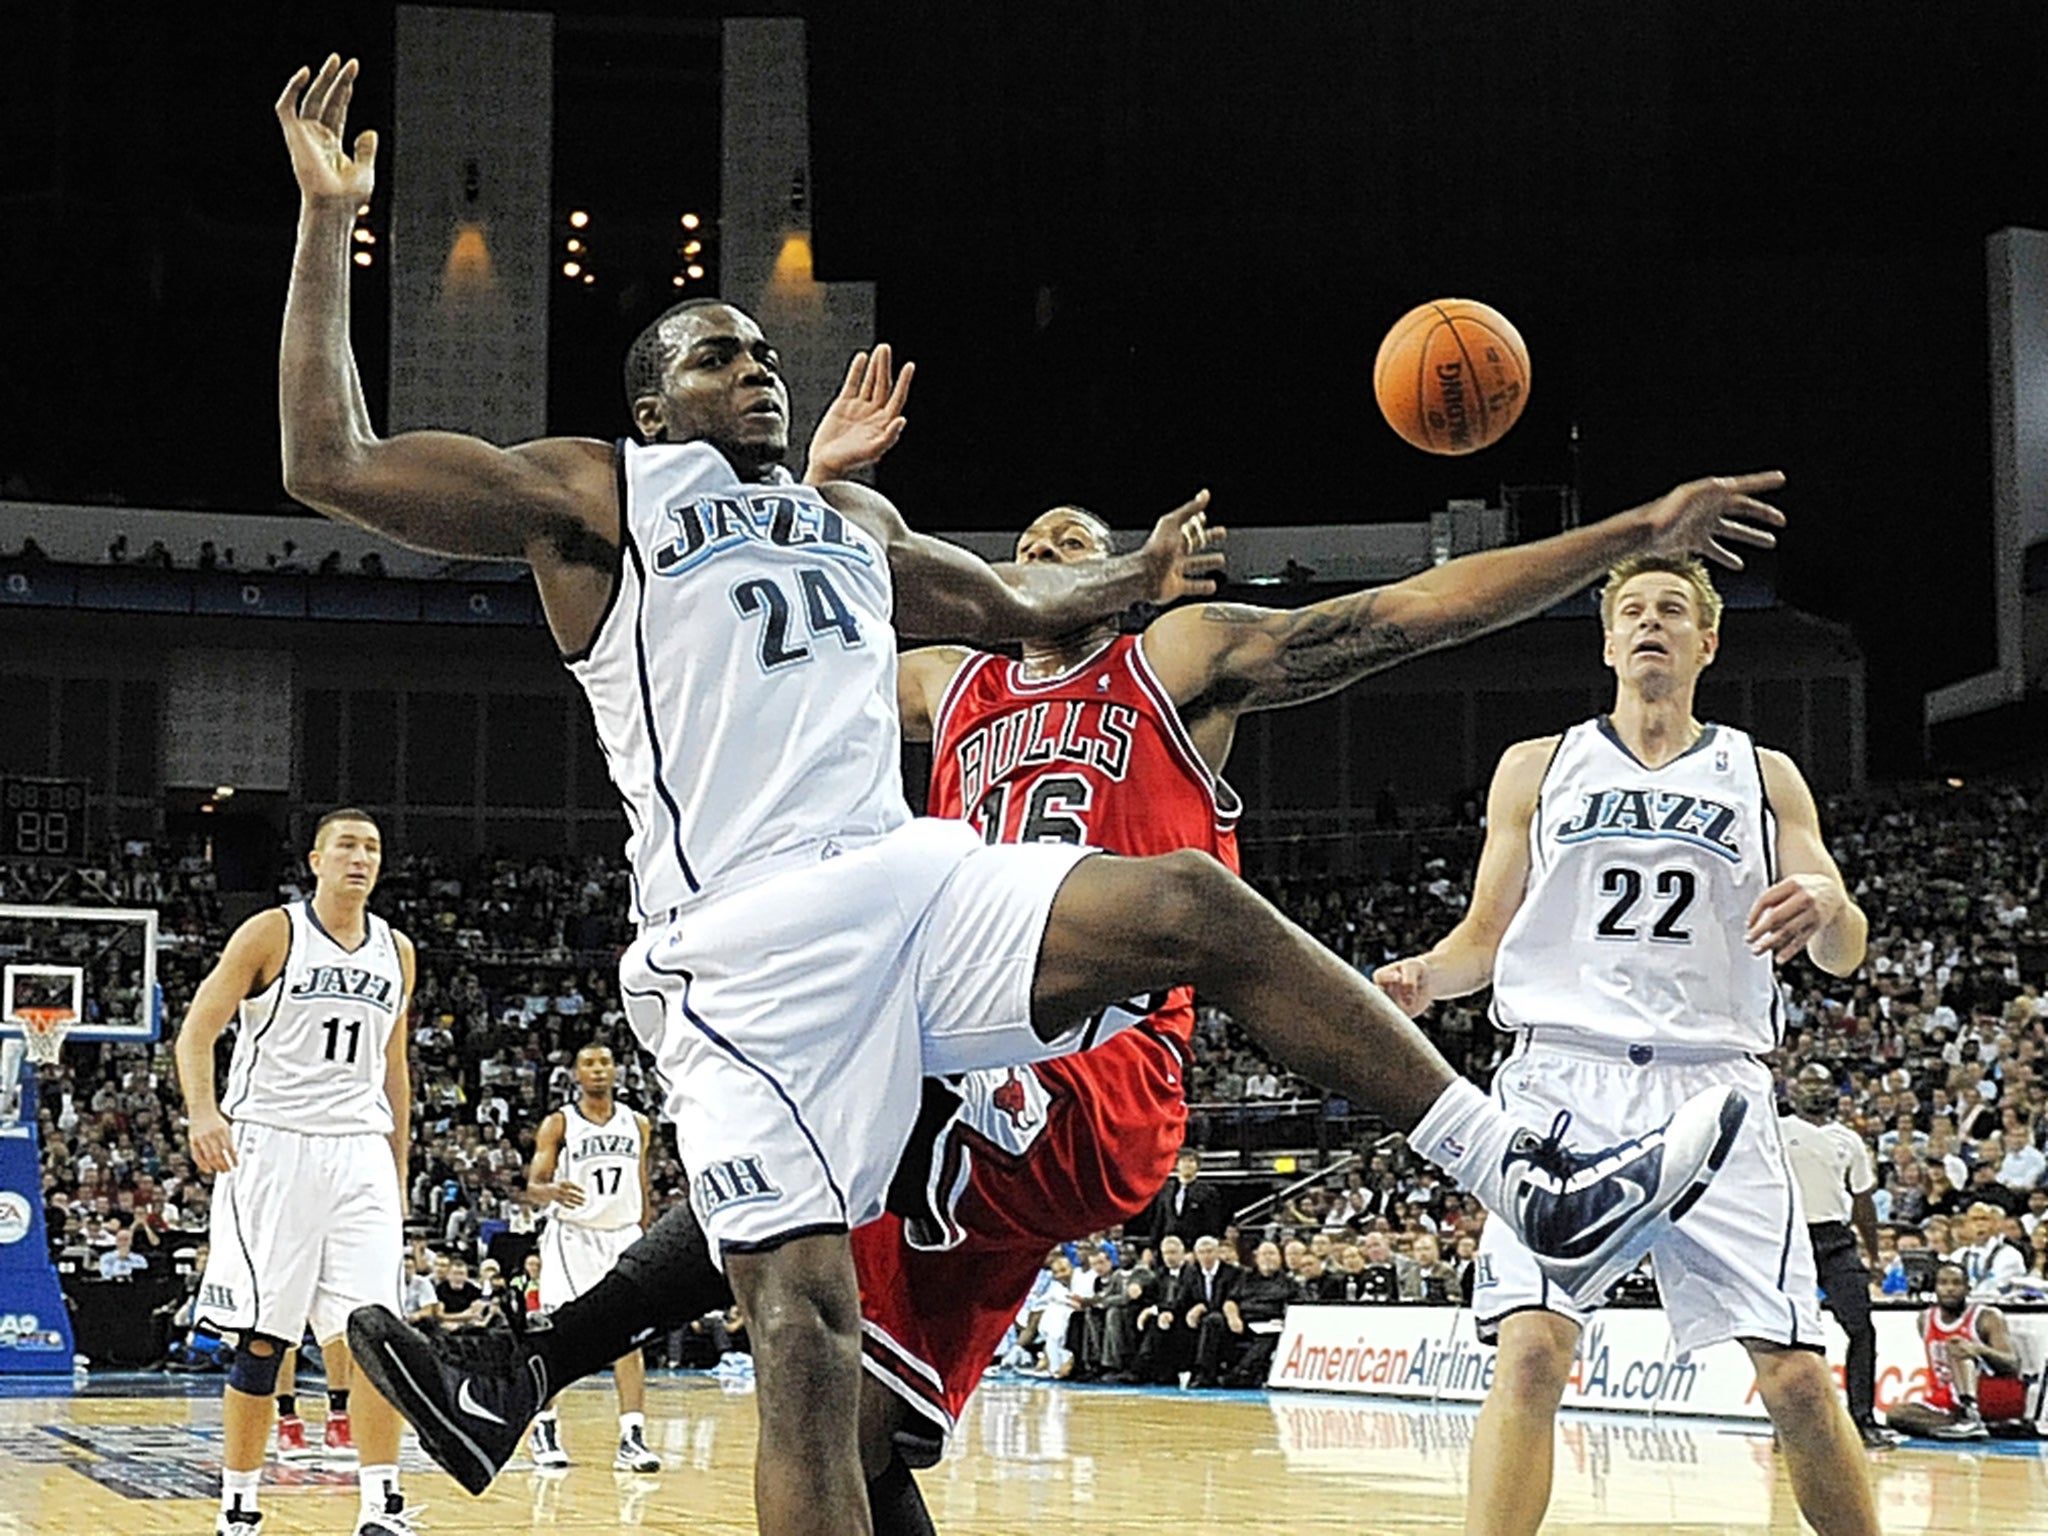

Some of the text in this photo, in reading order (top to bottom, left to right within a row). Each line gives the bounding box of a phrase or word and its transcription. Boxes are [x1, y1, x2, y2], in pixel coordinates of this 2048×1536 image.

[652, 493, 874, 576] JAZZ
[729, 567, 866, 675] 24
[957, 700, 1138, 818] BULLS
[977, 772, 1094, 846] 16
[1554, 787, 1742, 864] JAZZ
[1595, 866, 1696, 944] 22
[290, 965, 394, 1014] JAZZ
[322, 1017, 361, 1064] 11
[572, 1134, 639, 1161] JAZZ
[591, 1166, 623, 1196] 17
[1281, 1334, 1498, 1391] AmericanAirline
